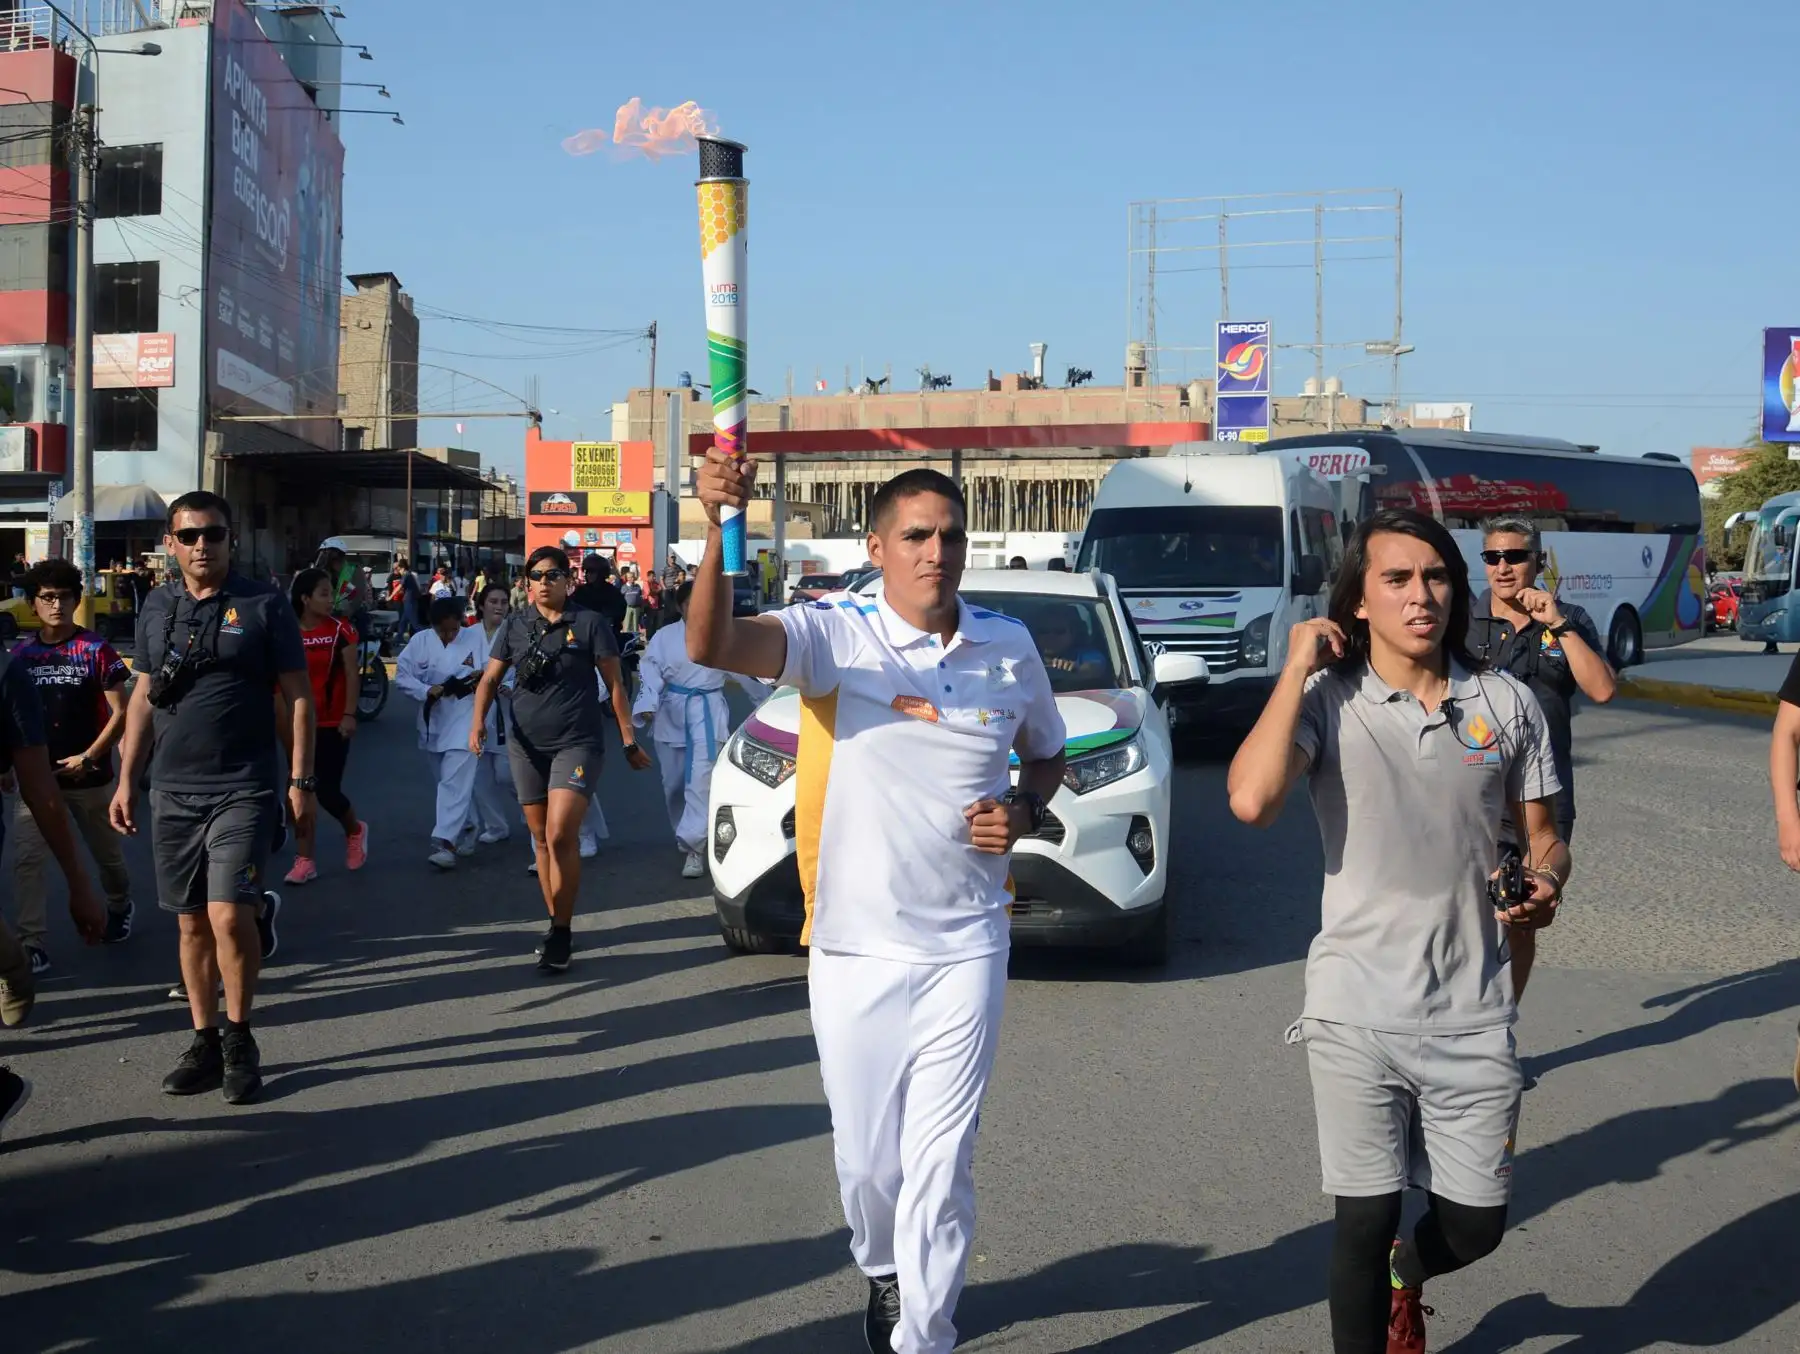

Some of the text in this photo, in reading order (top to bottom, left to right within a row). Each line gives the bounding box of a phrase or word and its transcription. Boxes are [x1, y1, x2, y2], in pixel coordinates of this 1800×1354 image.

[224, 54, 267, 136] APUNTA
[711, 294, 738, 304] 2019
[1221, 324, 1267, 334] HERCO
[577, 447, 615, 462] SE VENDE
